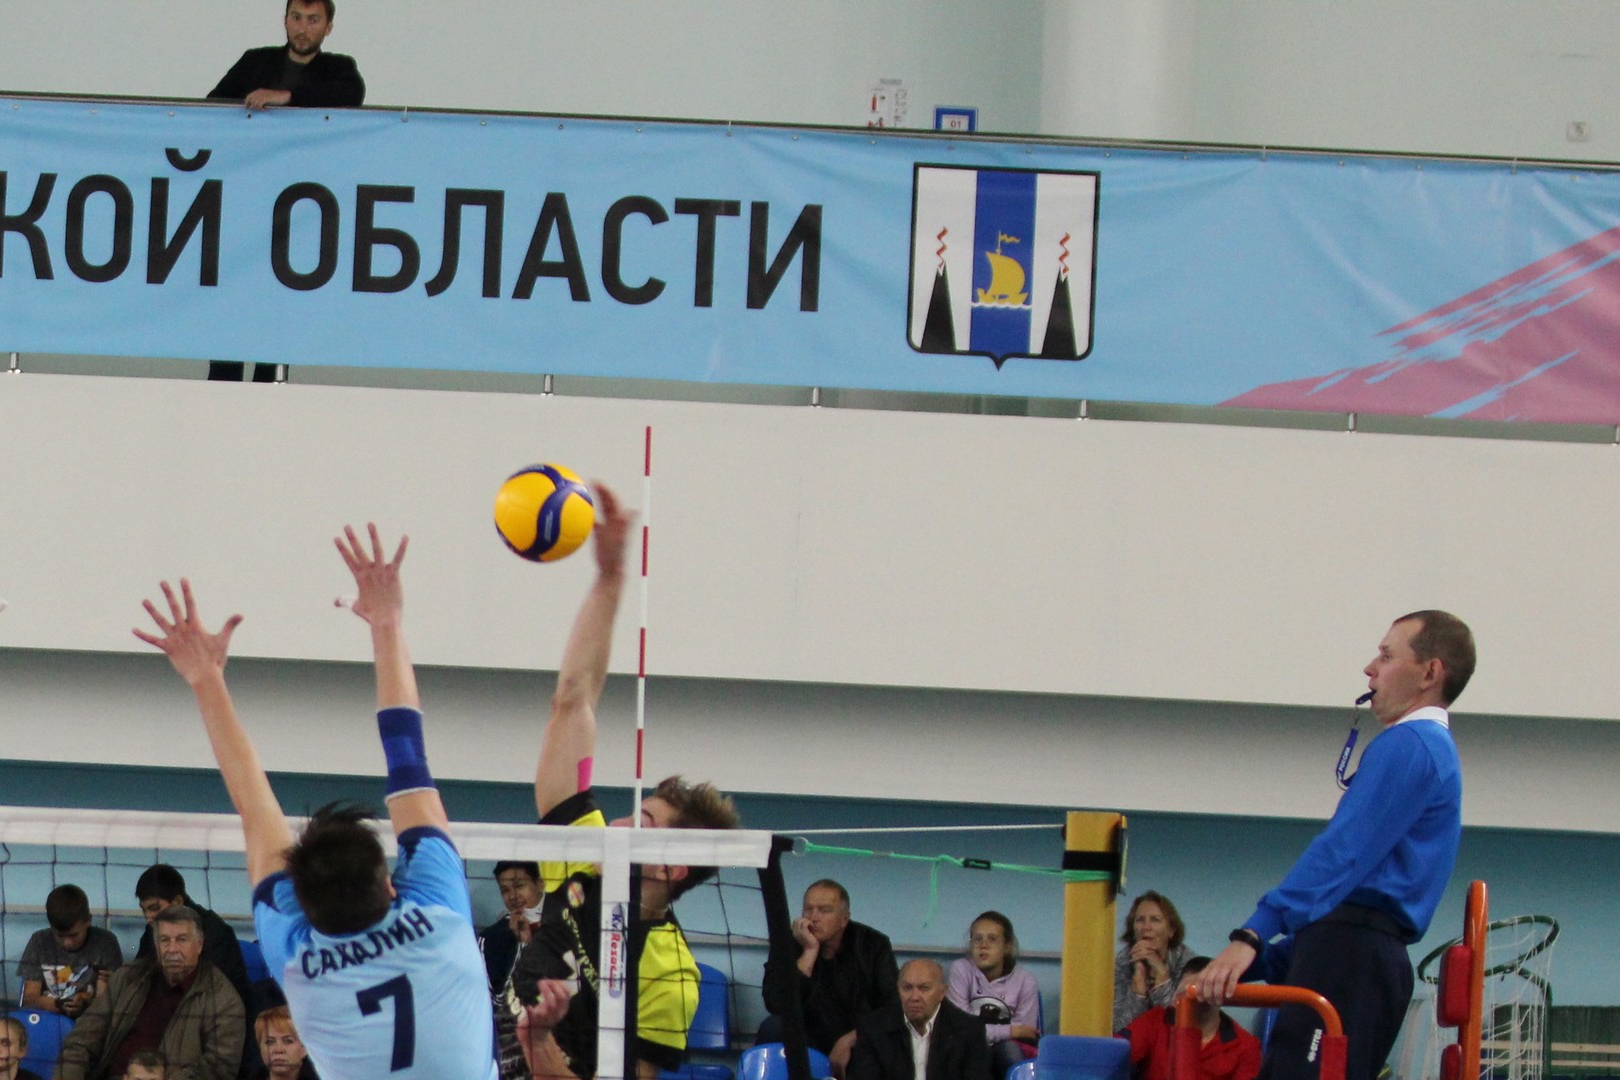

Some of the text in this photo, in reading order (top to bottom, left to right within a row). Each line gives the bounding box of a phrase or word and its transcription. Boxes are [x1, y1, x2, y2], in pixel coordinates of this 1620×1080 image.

[270, 181, 824, 313] ОБЛАСТИ
[301, 907, 435, 980] САХАЛИН
[356, 973, 416, 1073] 7
